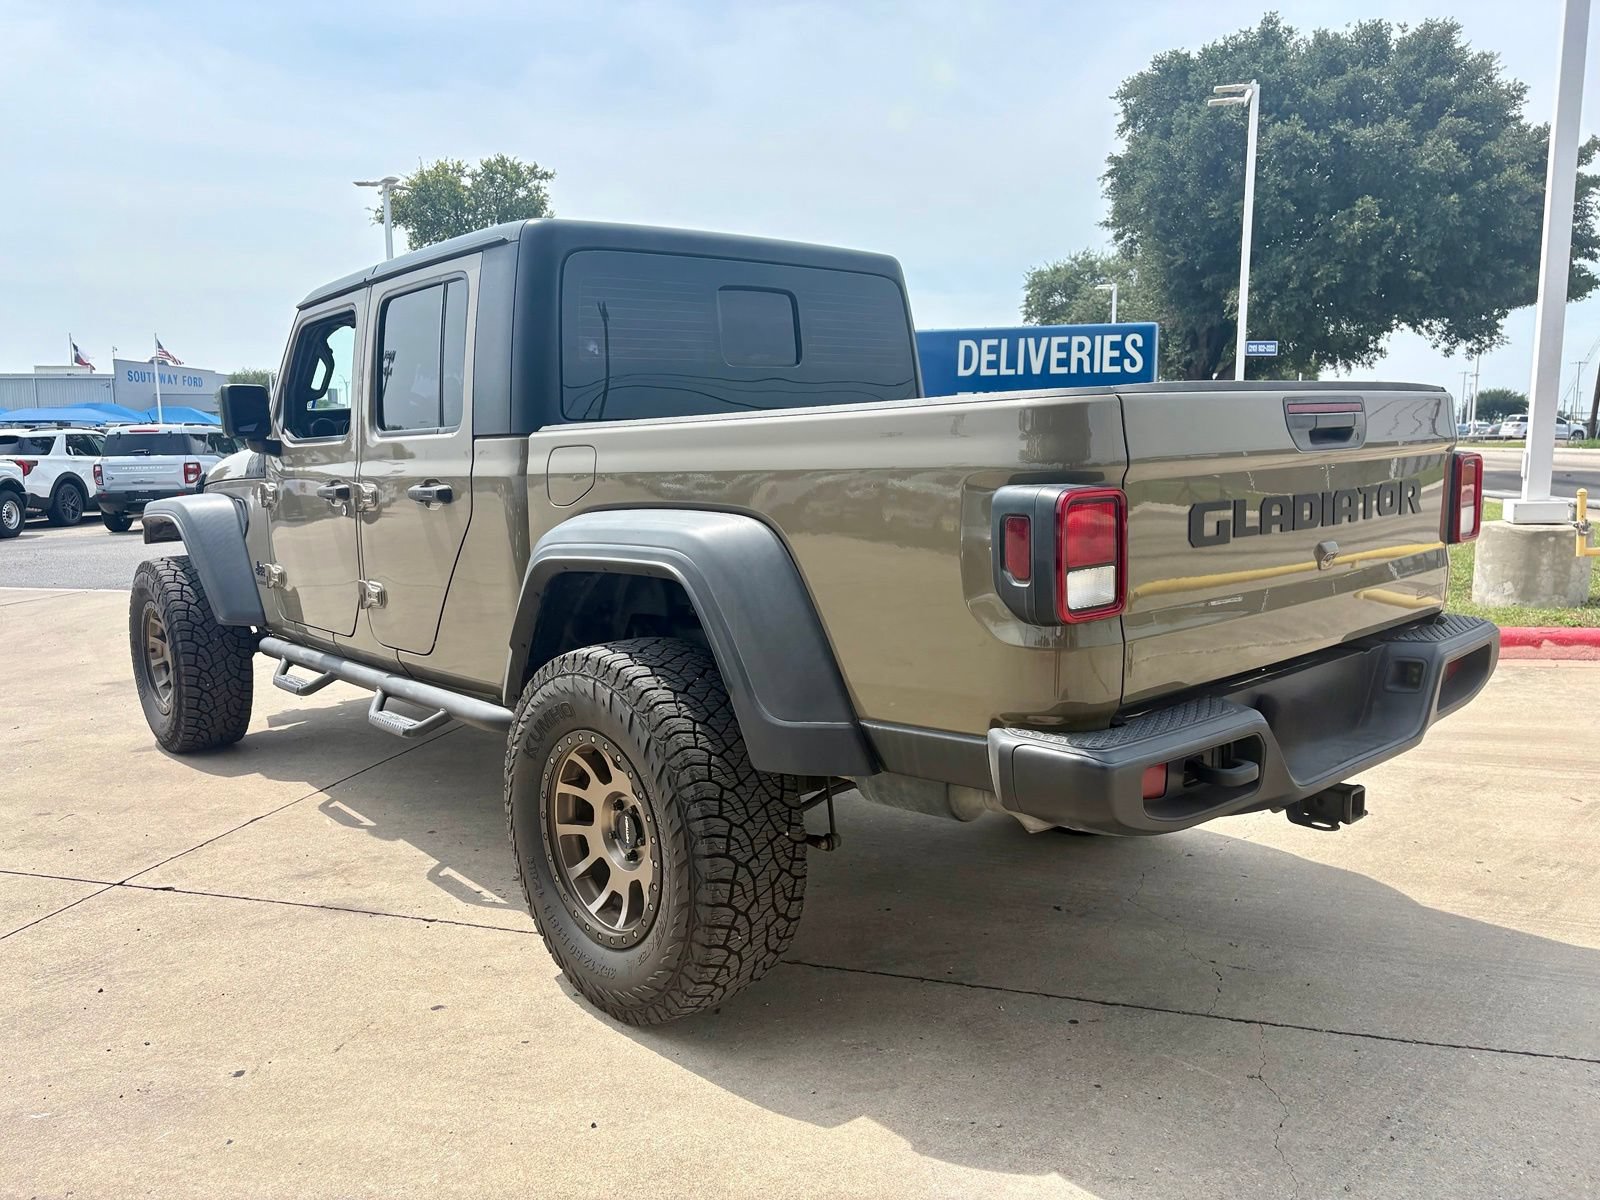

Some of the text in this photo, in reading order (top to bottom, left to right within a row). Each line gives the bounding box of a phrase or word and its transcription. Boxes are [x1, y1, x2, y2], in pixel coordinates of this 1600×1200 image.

[957, 333, 1144, 377] DELIVERIES
[182, 375, 204, 387] FORD
[1188, 478, 1422, 548] GLADIATOR
[522, 701, 576, 760] KUMHO
